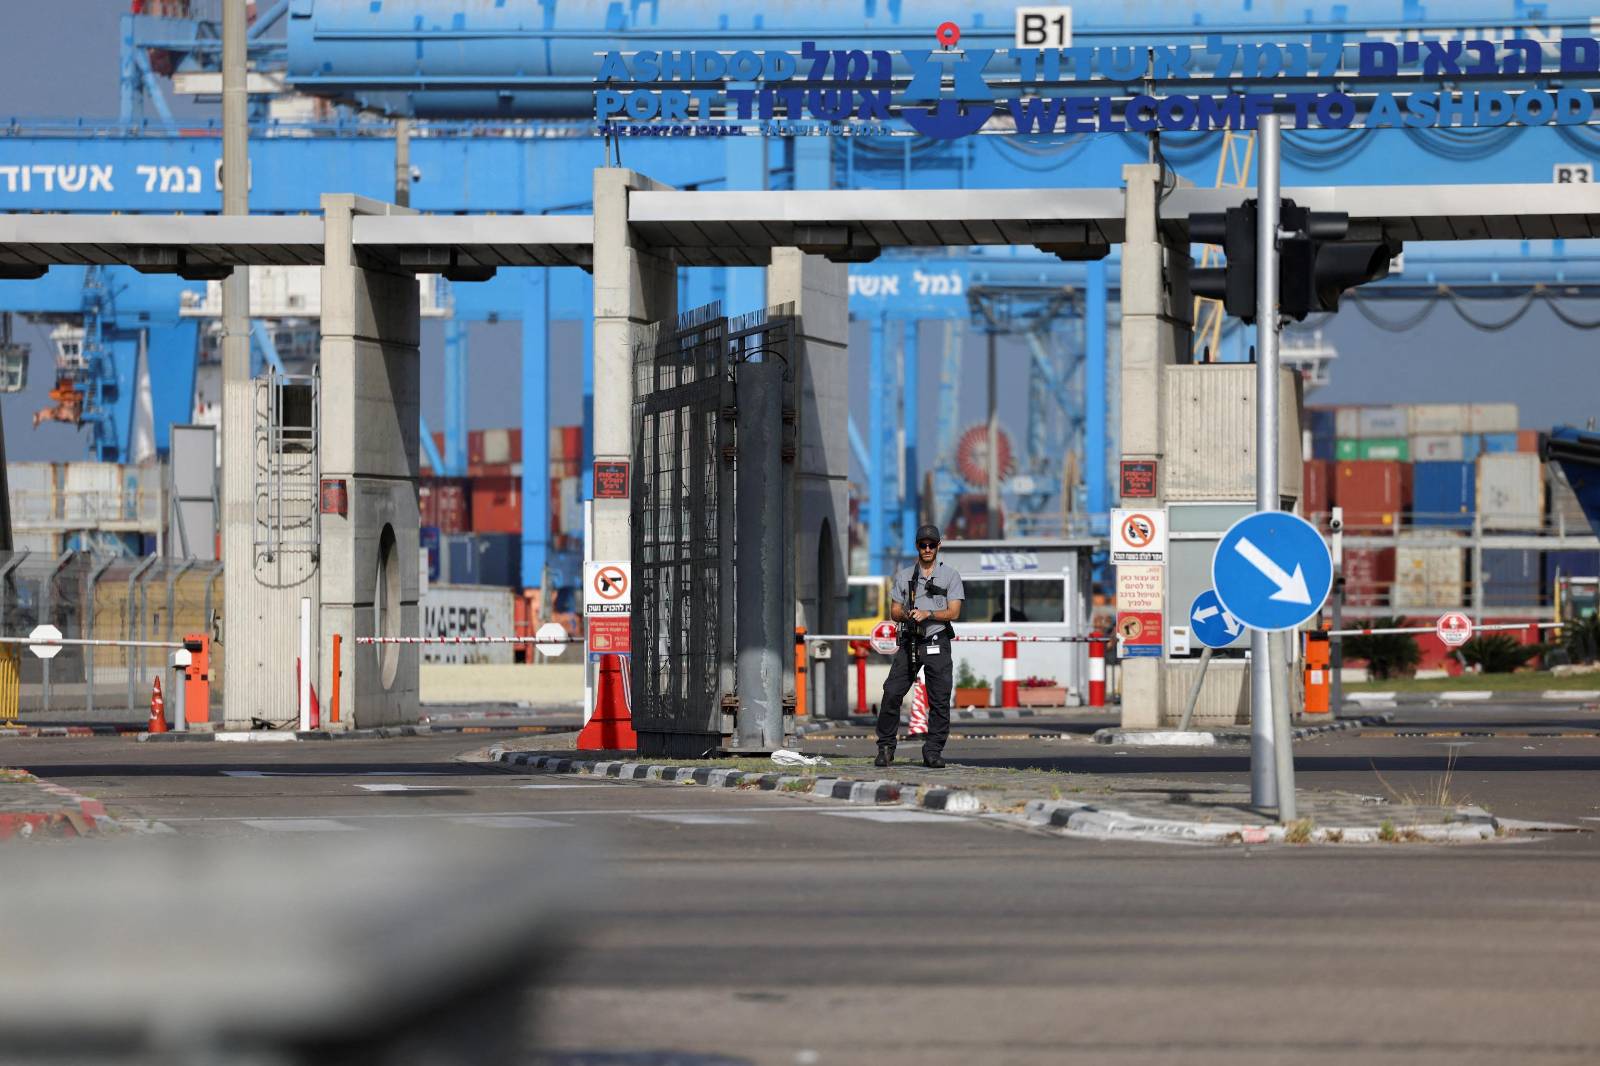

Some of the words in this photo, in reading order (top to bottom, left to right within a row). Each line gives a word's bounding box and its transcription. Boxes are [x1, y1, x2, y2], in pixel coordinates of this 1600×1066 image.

[1022, 14, 1066, 45] B1
[596, 50, 796, 81] ASHDOD
[802, 41, 892, 81] נמל
[1008, 45, 1191, 81] אשדוד
[1206, 34, 1347, 78] לנמל
[1360, 39, 1542, 76] הבאים
[595, 90, 718, 121] PORT
[727, 89, 893, 120] אשדוד
[1010, 93, 1275, 134] WELCOME
[1286, 92, 1356, 130] TO
[1366, 89, 1594, 128] ASHDOD
[0, 165, 114, 193] אשדוד
[136, 165, 202, 193] נמל
[914, 269, 962, 296] נמל
